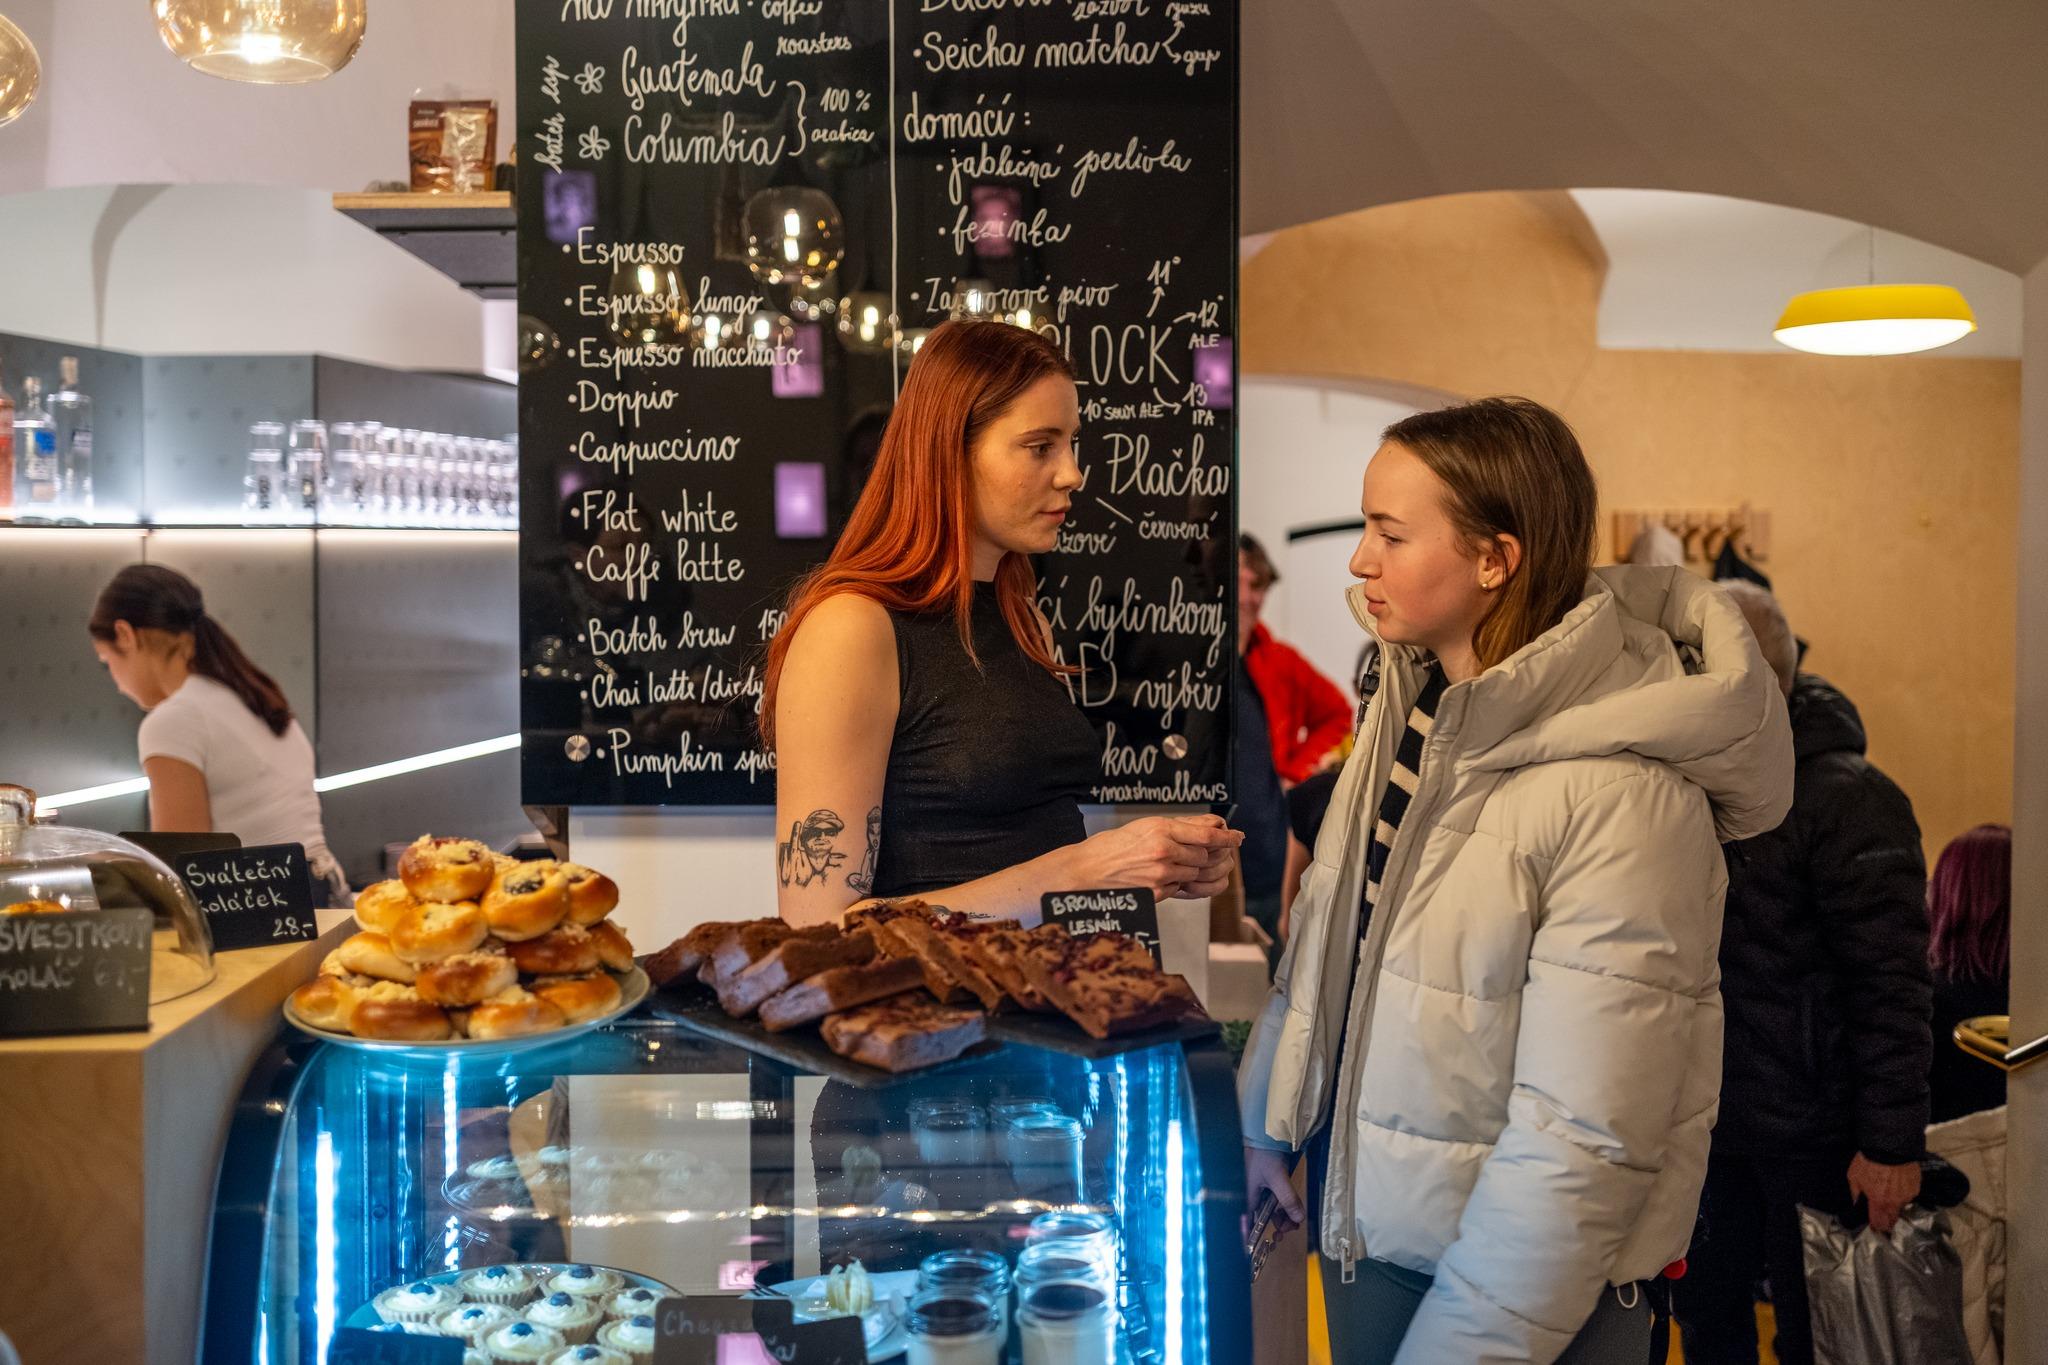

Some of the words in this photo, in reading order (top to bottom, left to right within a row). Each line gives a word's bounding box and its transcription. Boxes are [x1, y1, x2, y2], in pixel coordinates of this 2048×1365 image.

[776, 31, 853, 57] roasters
[922, 25, 1026, 73] Seicha
[1034, 21, 1161, 68] matcha
[621, 40, 777, 111] Guatemala
[623, 111, 786, 166] Columbia
[811, 118, 875, 143] arabica
[576, 226, 685, 274] Espresso
[578, 284, 680, 328] Espresso
[692, 275, 764, 334] lungo
[1057, 278, 1119, 323] pivo
[578, 337, 684, 381] Espresso
[693, 333, 803, 368] macchiato
[1188, 333, 1221, 350] ALE
[576, 379, 679, 428] Doppio
[1192, 410, 1215, 426] IPA
[577, 428, 741, 476] Cappuccino
[1102, 432, 1230, 497] Plačka
[582, 490, 642, 533] Flat
[661, 488, 739, 533] white
[677, 537, 746, 583] latte
[588, 615, 667, 657] Batch
[678, 610, 737, 650] brew
[1076, 575, 1227, 668] bylinkový
[591, 672, 641, 709] Chai
[1132, 660, 1222, 730] výběr
[607, 728, 723, 789] Pumpkin
[734, 745, 777, 785] spic
[186, 854, 292, 887] Sváteční
[1051, 890, 1138, 916] BROWNIES
